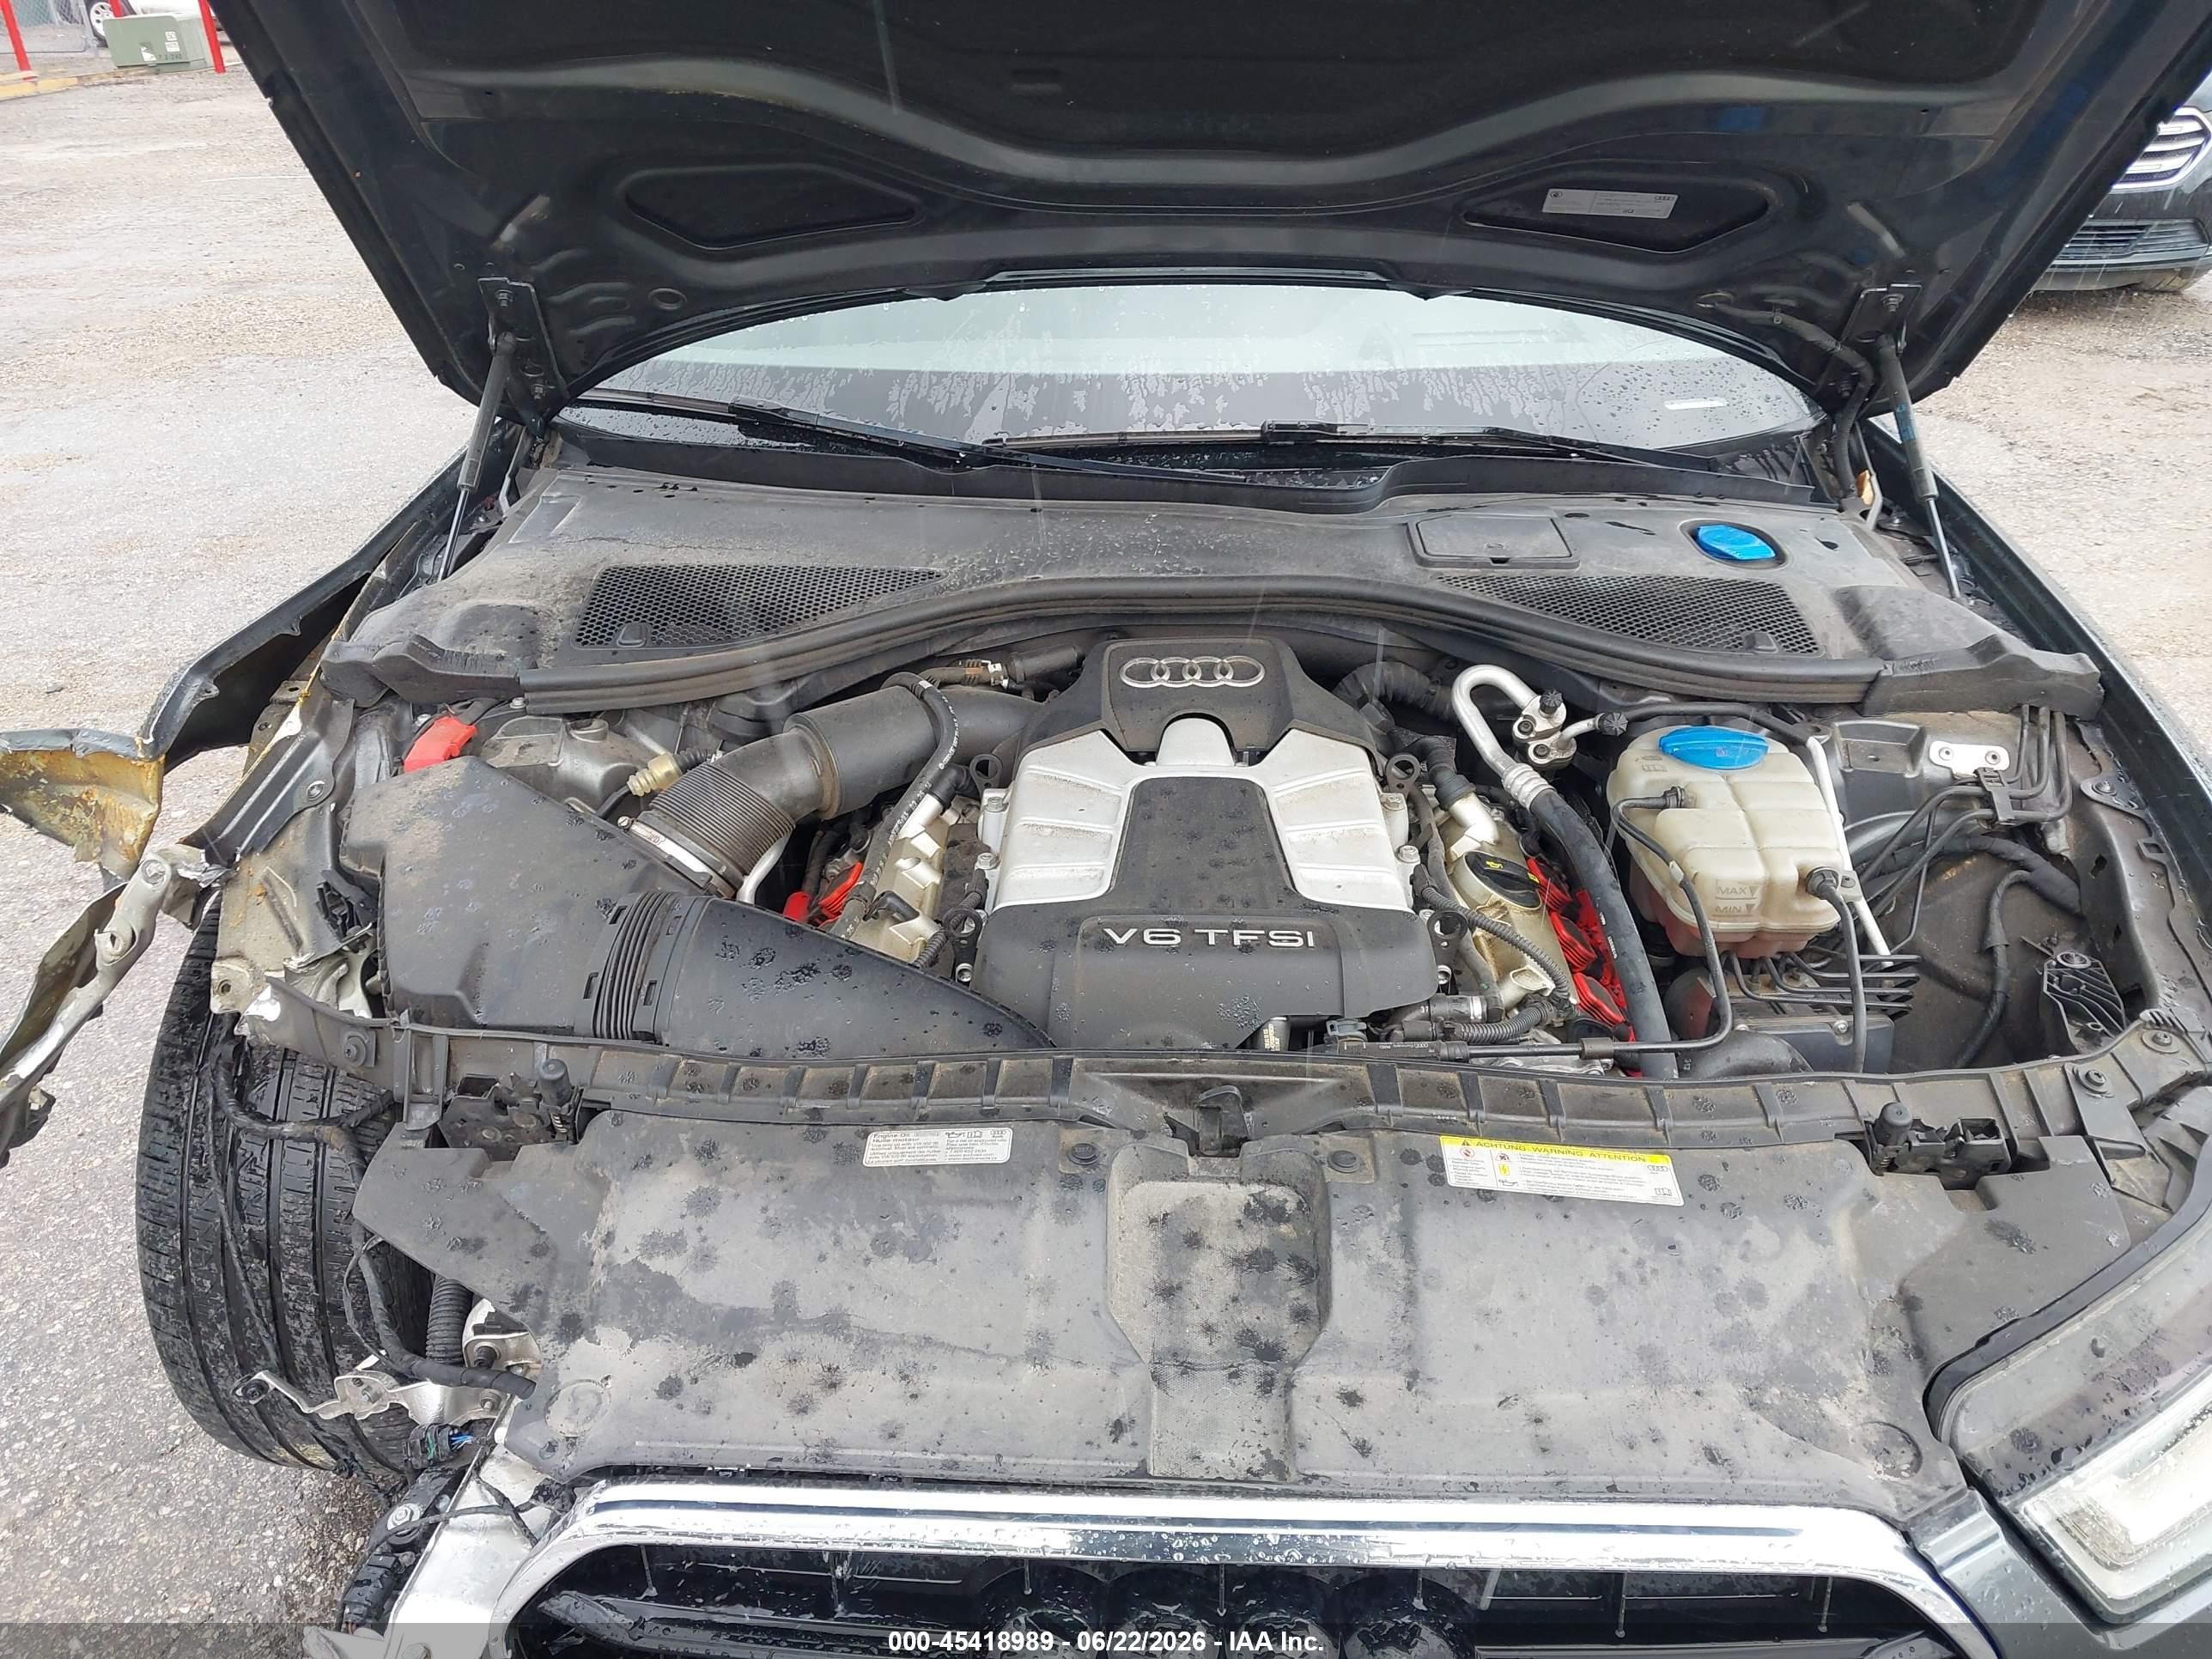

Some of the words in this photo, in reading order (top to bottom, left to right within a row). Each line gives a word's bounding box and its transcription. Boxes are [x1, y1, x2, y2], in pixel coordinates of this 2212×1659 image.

[1717, 886, 1747, 895] MAX
[1103, 928, 1182, 946] V6
[1194, 928, 1315, 948] TFSI
[1476, 1141, 1527, 1152] ACHTUNG
[1531, 1146, 1583, 1157] WARNING
[1589, 1152, 1646, 1163] ATTENTION
